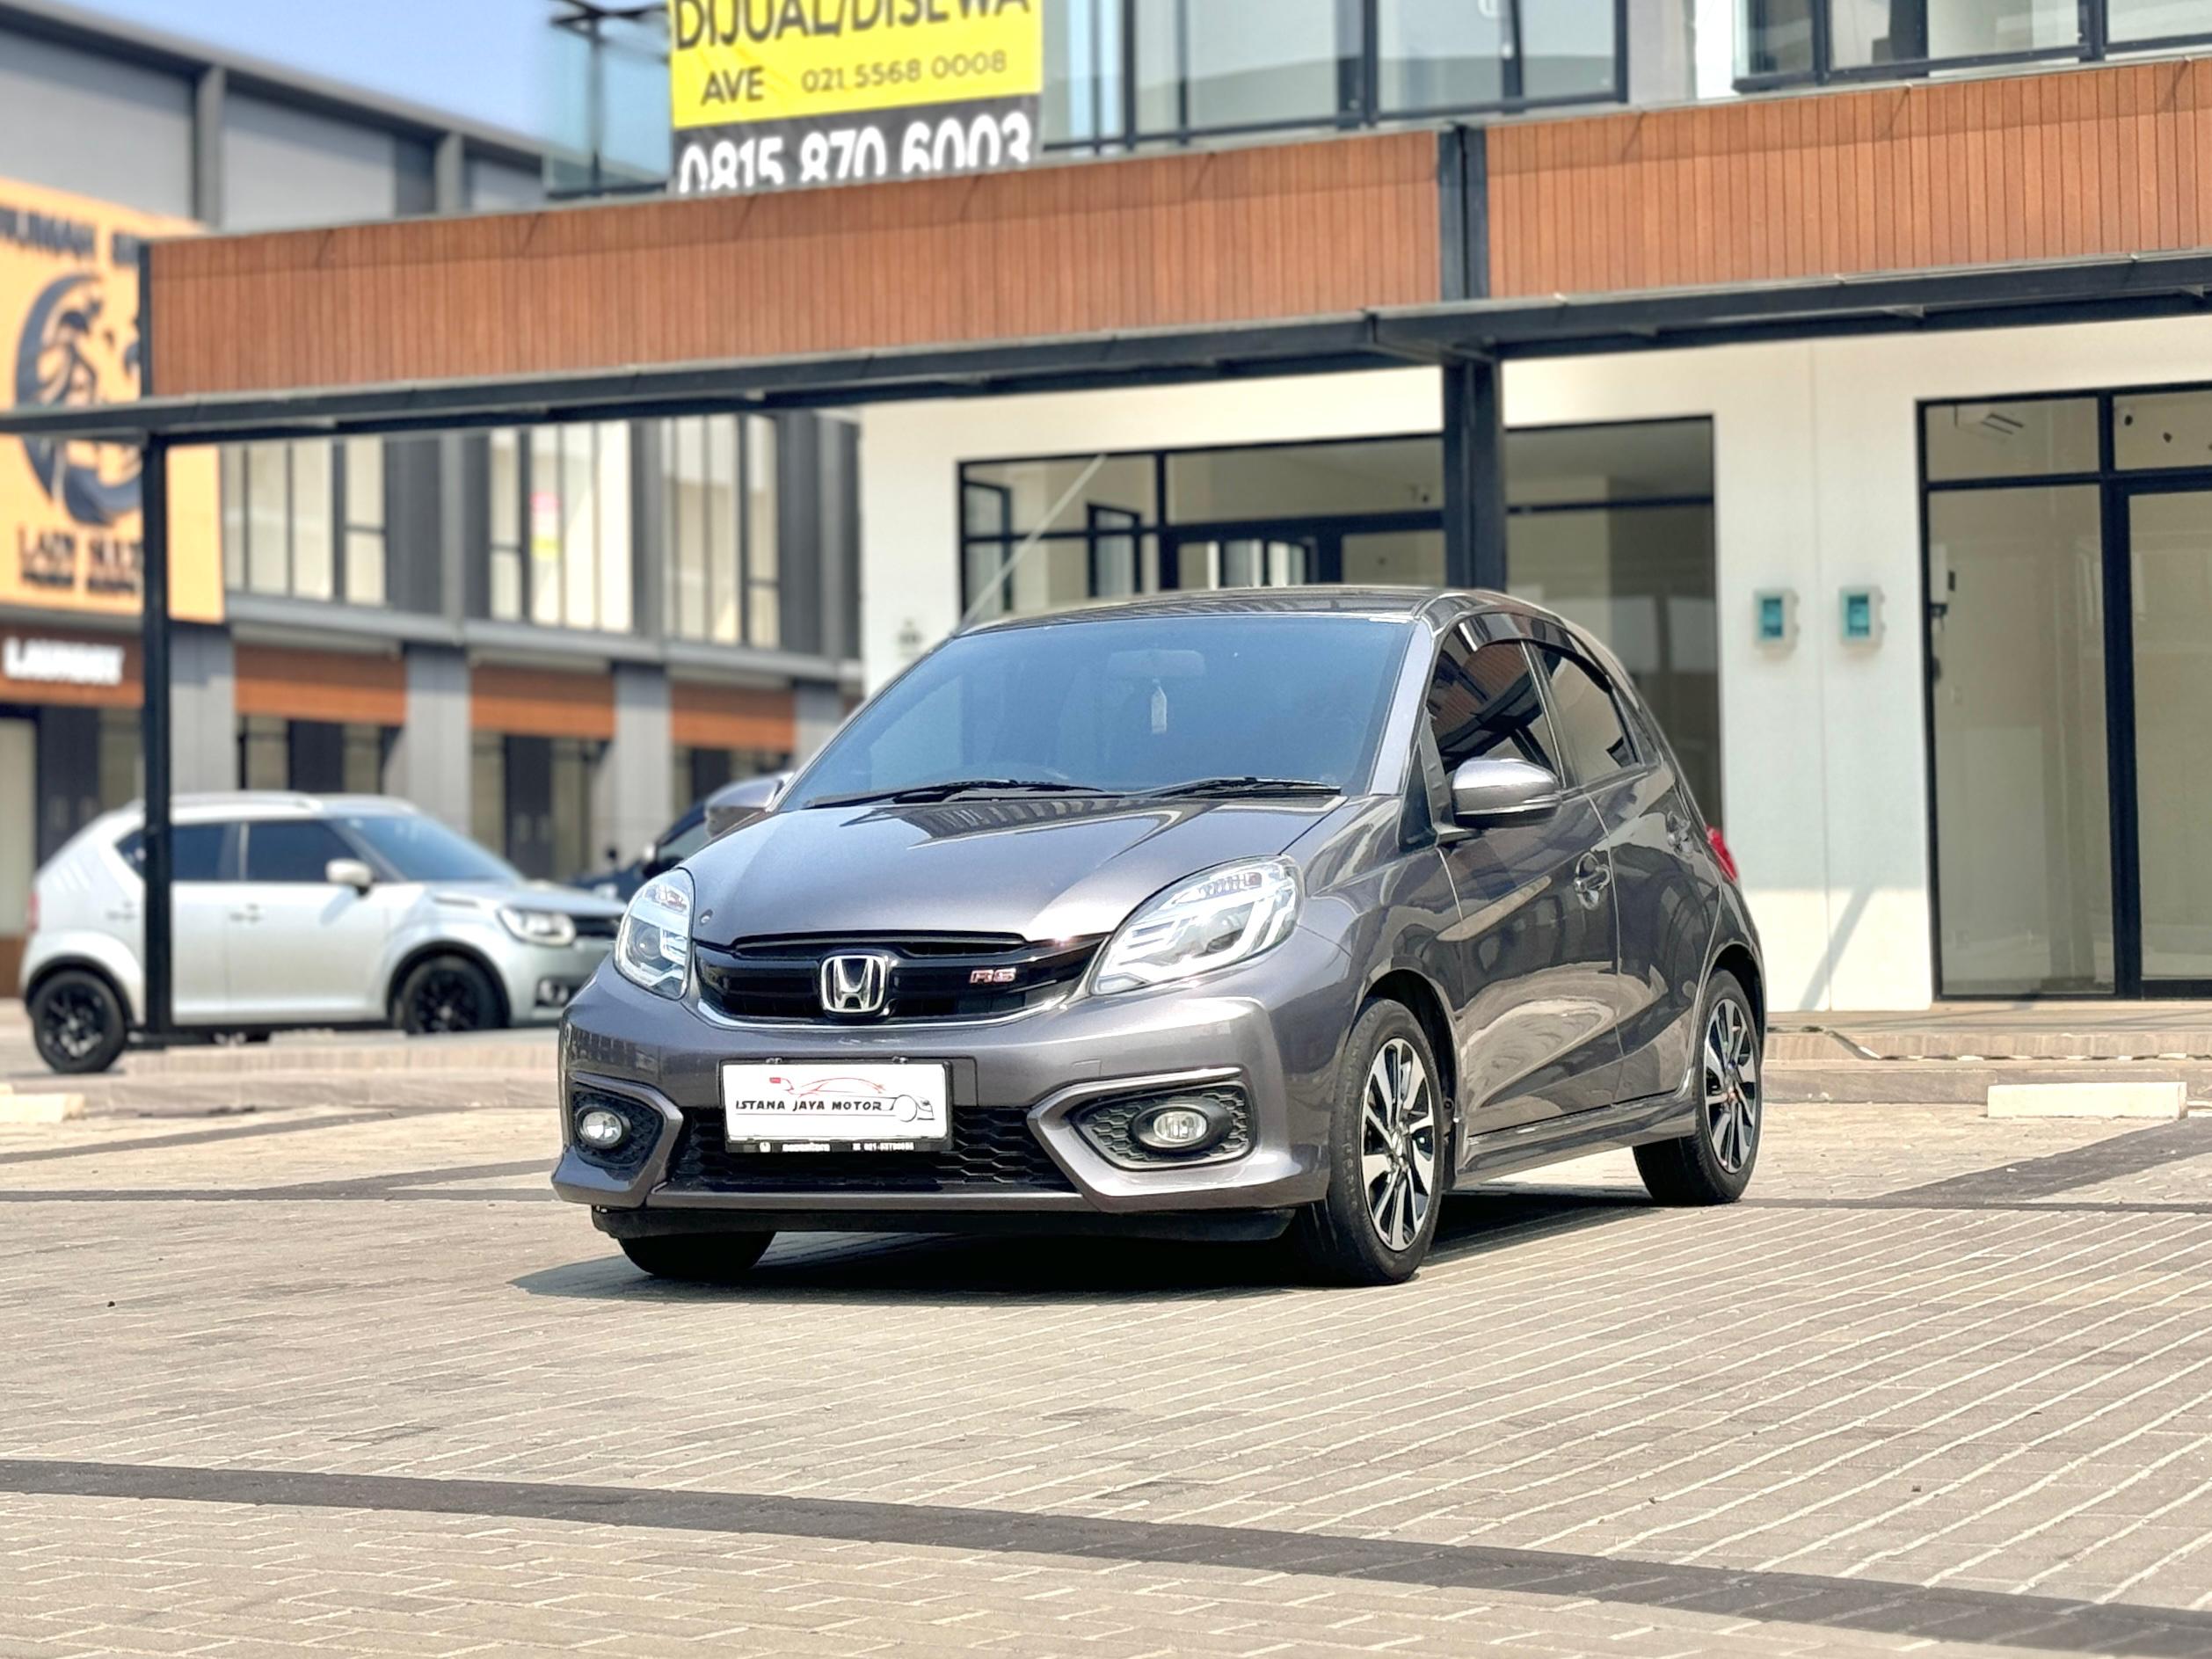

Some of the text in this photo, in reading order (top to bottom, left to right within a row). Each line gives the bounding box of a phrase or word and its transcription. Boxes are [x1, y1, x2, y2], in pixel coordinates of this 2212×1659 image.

[675, 0, 1031, 50] DIJUAL/D
[701, 49, 1008, 105] AVE 021 5568 0008
[679, 136, 784, 193] 0815
[800, 127, 887, 183] 870
[970, 967, 1017, 984] RS
[735, 1100, 883, 1112] ISTANA JAYA MOTOR
